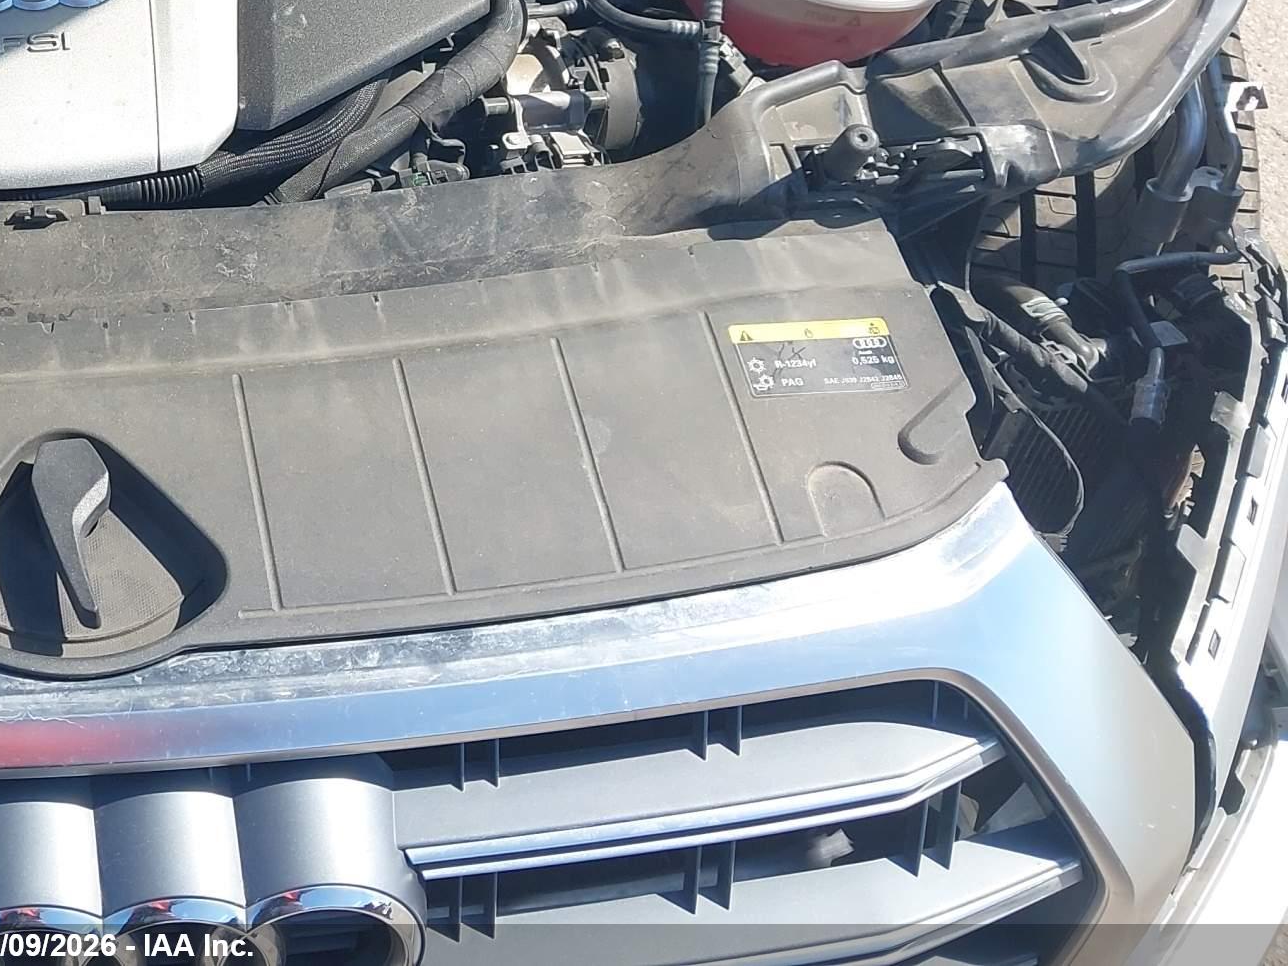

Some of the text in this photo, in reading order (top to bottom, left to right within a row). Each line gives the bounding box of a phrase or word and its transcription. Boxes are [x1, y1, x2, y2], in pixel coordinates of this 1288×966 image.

[774, 358, 817, 369] R-1234yf
[851, 355, 895, 366] 0,525 kg
[781, 377, 804, 386] PAG
